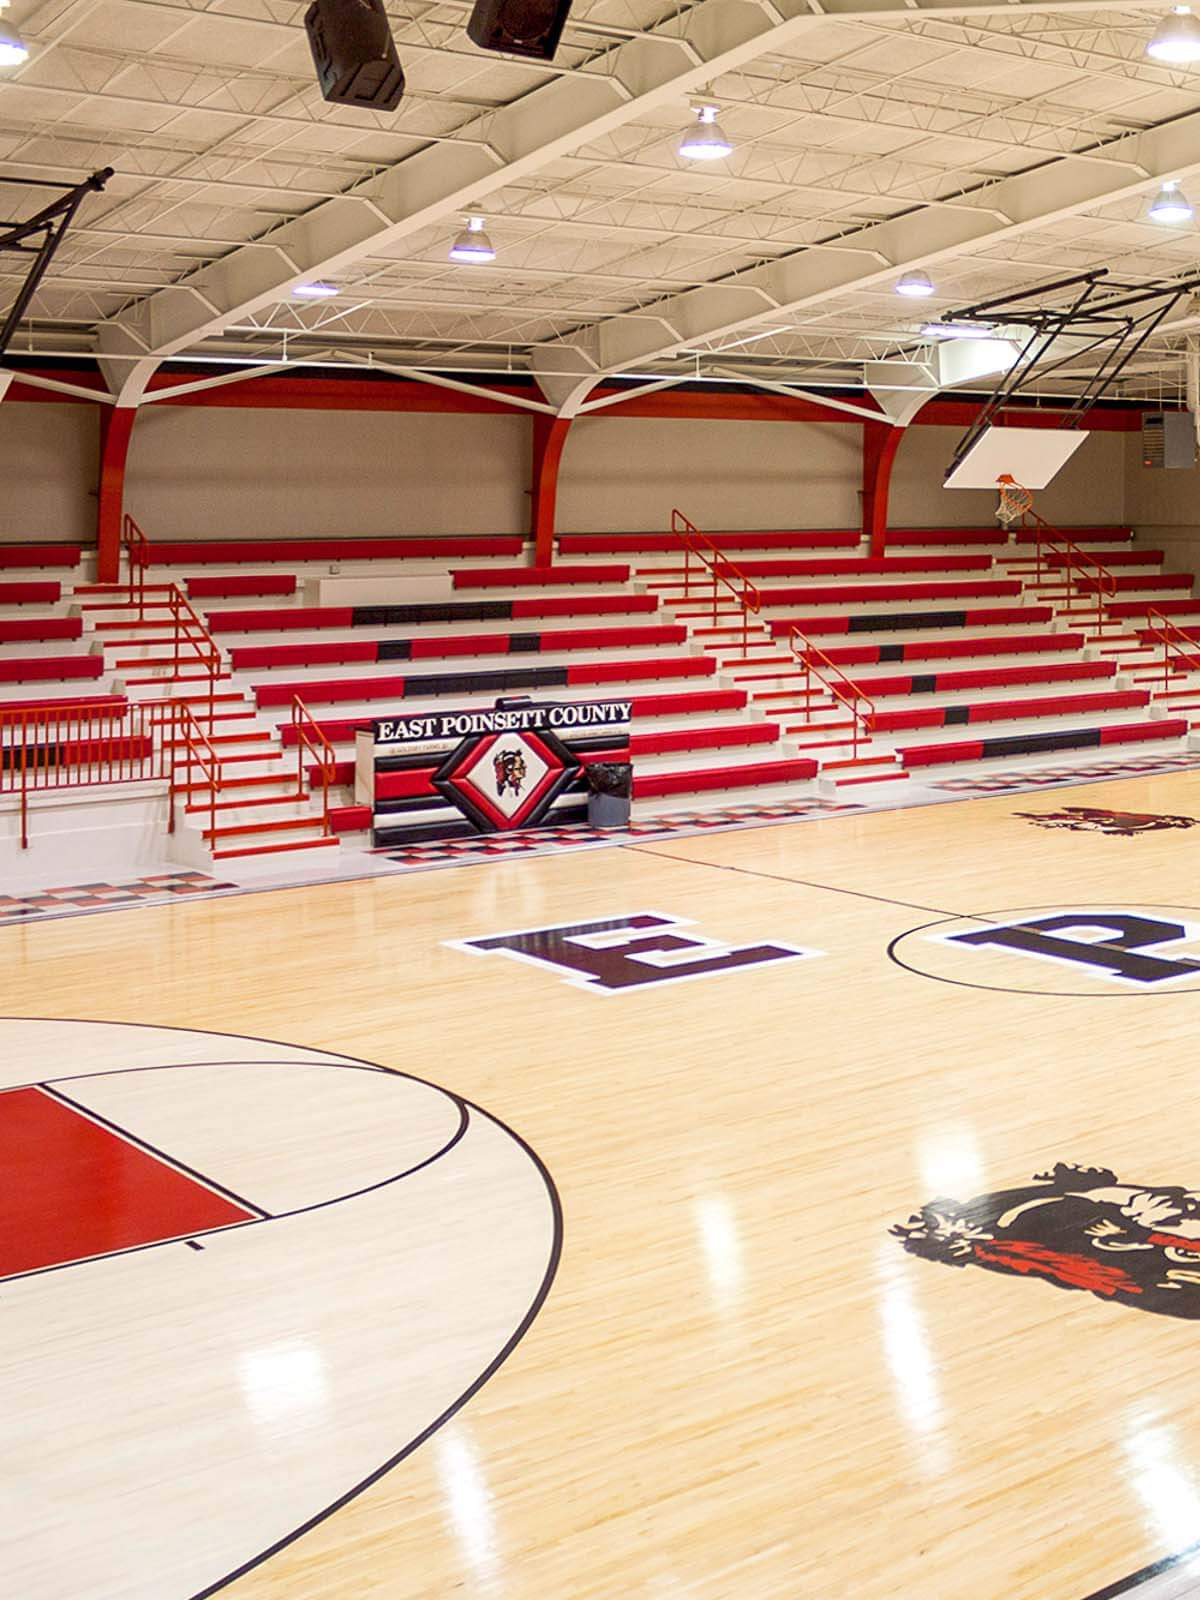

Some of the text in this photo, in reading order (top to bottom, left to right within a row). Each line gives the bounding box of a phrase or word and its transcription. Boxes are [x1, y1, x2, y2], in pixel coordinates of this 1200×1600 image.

[378, 703, 632, 742] EAST POINSETT COUNTY
[439, 910, 827, 994] E
